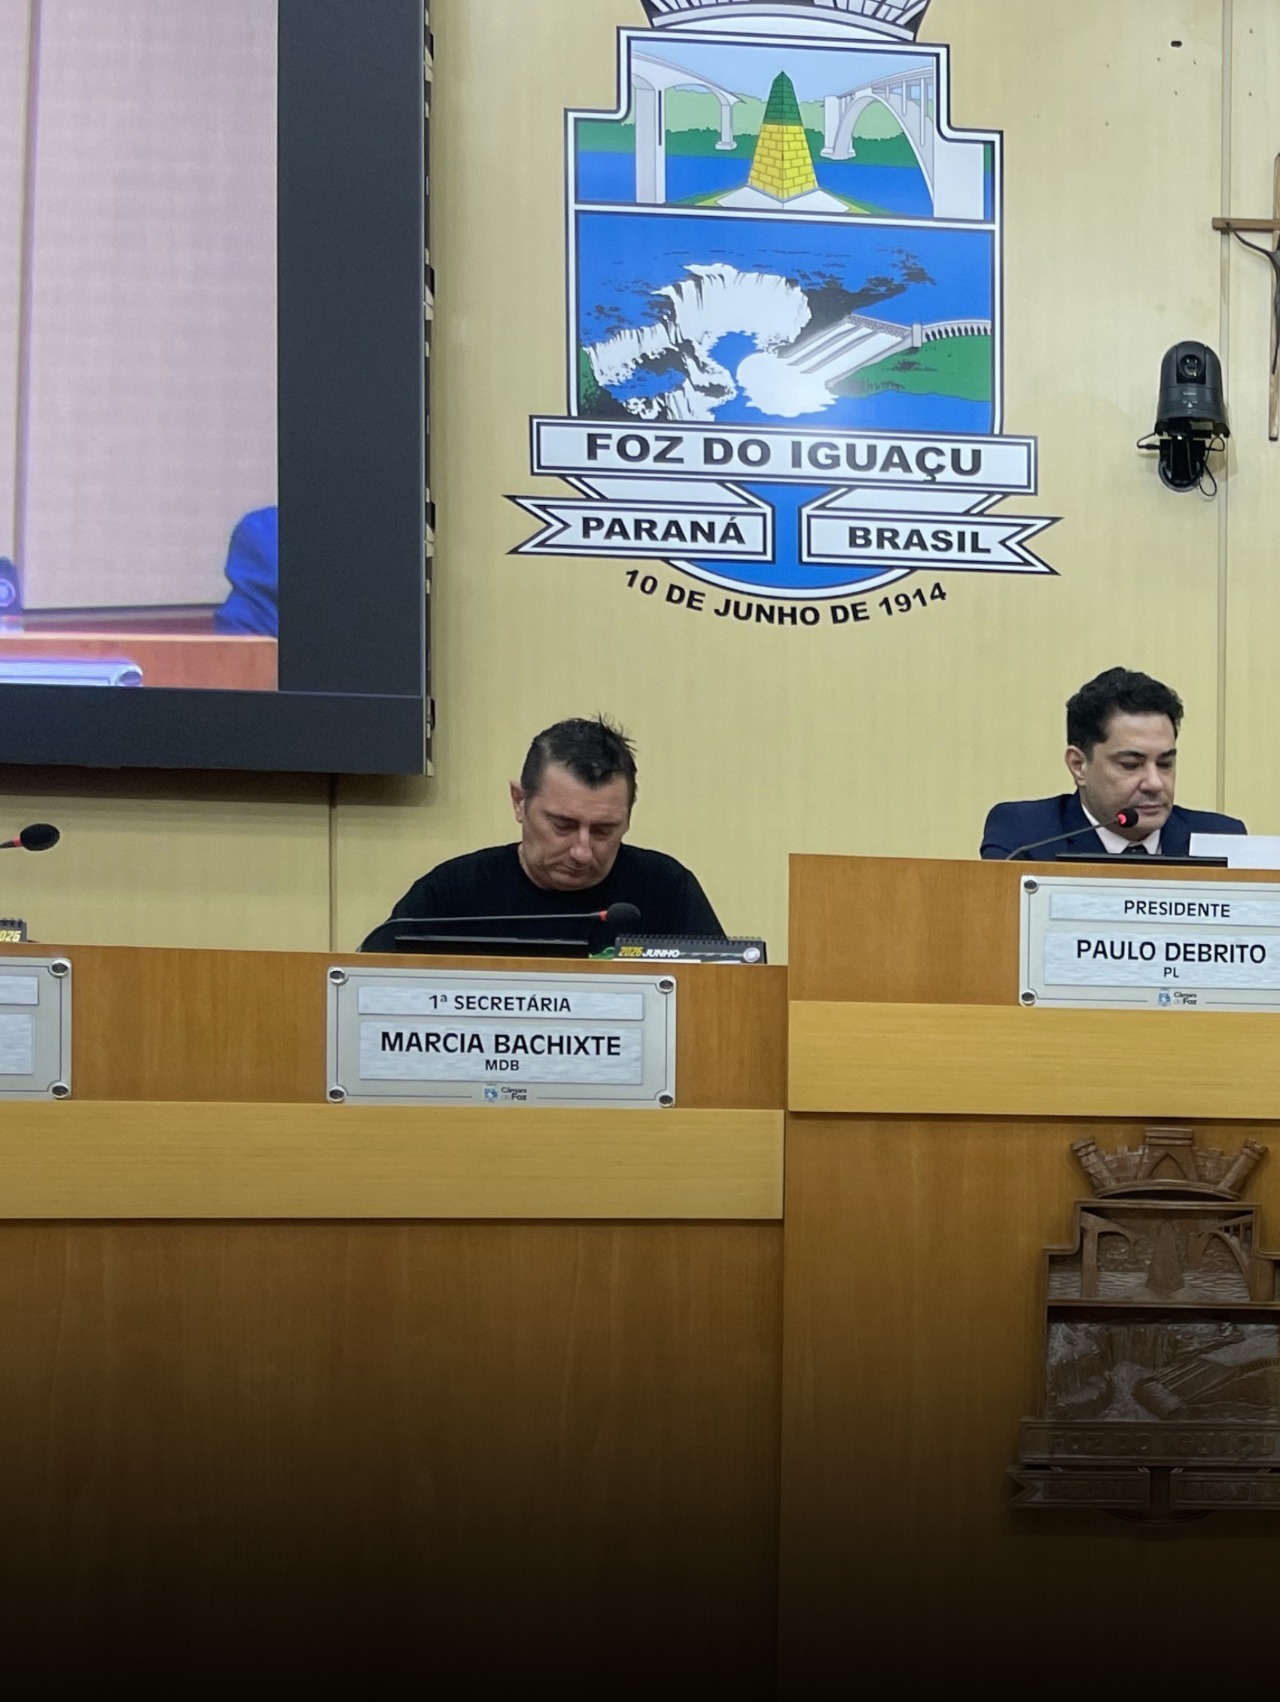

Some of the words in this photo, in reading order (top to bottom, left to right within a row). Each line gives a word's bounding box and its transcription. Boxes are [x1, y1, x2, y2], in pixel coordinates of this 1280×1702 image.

[586, 433, 684, 465] FOZ
[704, 437, 772, 468] DO
[791, 441, 983, 482] IGUAÇU
[581, 515, 746, 545] PARANÁ
[848, 526, 992, 555] BRASIL
[625, 569, 658, 595] 10
[666, 585, 706, 611] DE
[714, 598, 820, 626] JUNHO
[831, 600, 870, 625] DE
[878, 581, 947, 617] 1914
[1124, 899, 1231, 918] PRESIDENTE
[0, 930, 21, 942] 026
[618, 946, 643, 957] 2026
[642, 948, 680, 958] JUNHO
[1077, 939, 1156, 961] PAULO
[1165, 942, 1267, 964] DEBRITO
[1163, 966, 1180, 979] PL
[454, 994, 572, 1012] SECRETÁRIA
[381, 1031, 485, 1054] MARCIA
[494, 1033, 621, 1056] BACHIXTE
[485, 1058, 520, 1072] MDB
